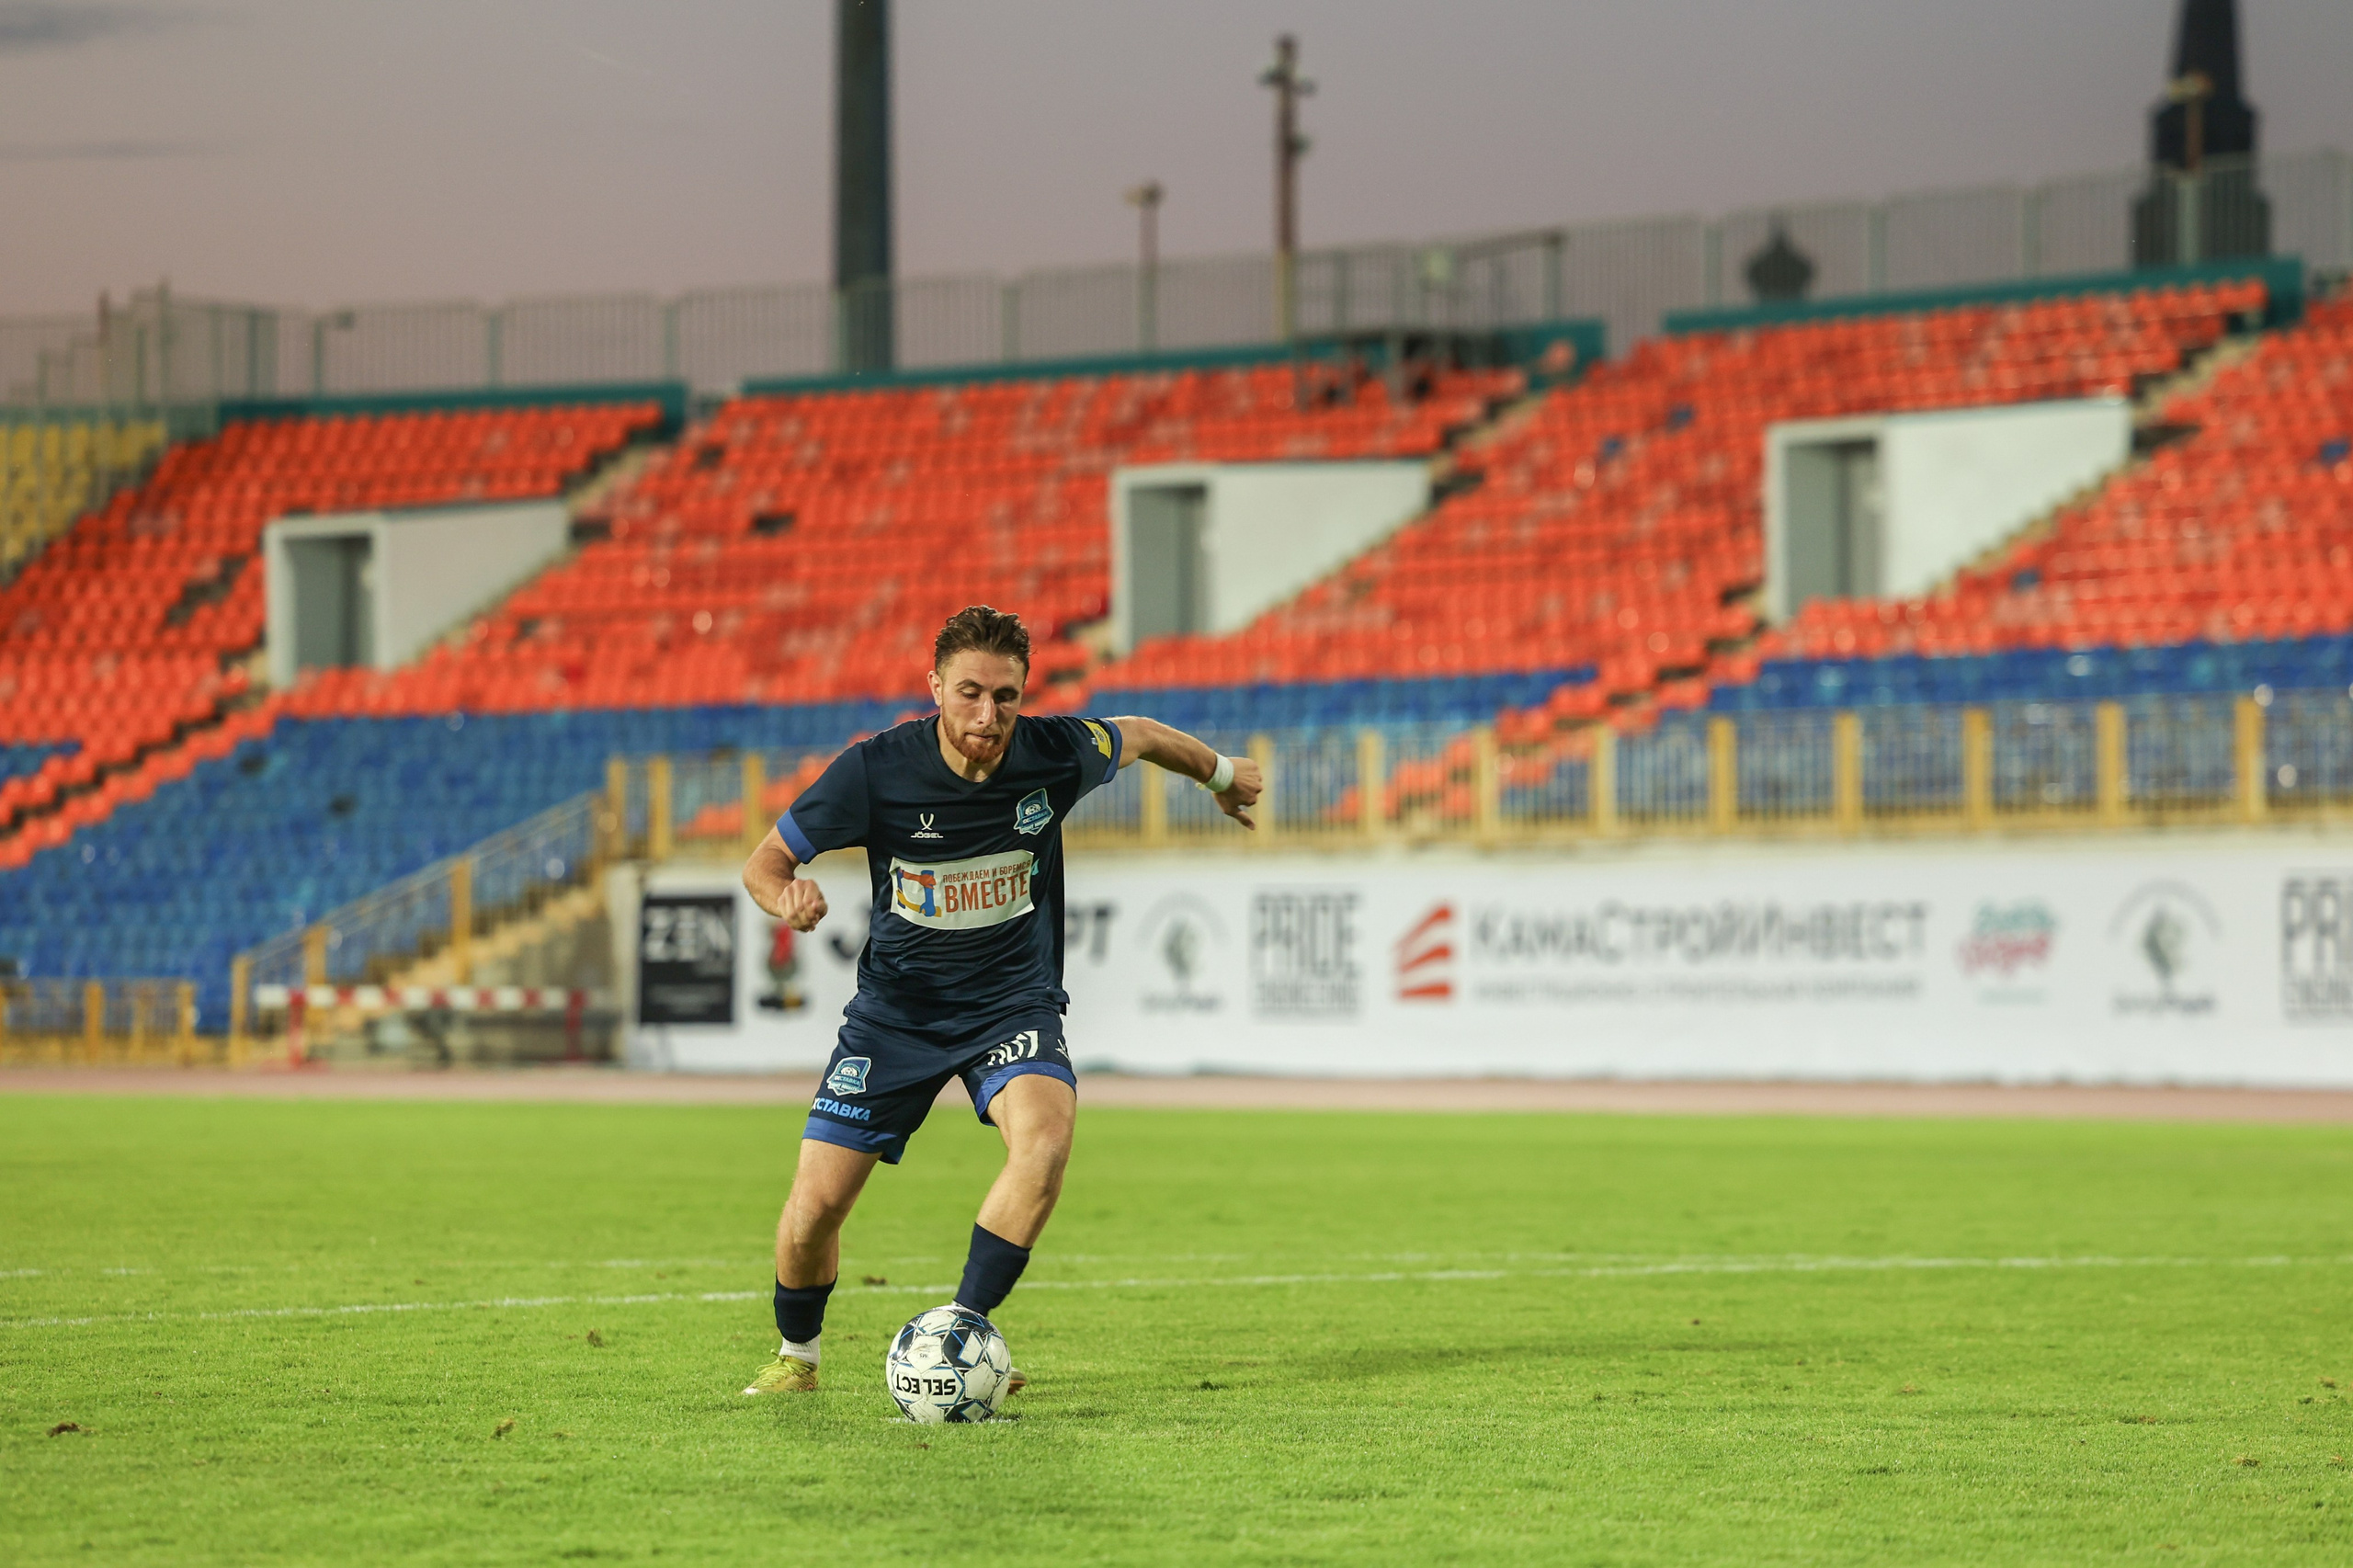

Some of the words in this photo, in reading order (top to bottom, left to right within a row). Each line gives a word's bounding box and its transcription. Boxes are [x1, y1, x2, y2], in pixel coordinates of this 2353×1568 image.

[943, 869, 990, 883] ПОБЕЖДАЕМ
[992, 868, 997, 878] И
[999, 860, 1030, 875] БОРЕМСЯ
[944, 869, 1029, 913] ВМЕСТЕ
[896, 1373, 956, 1396] SELECT
